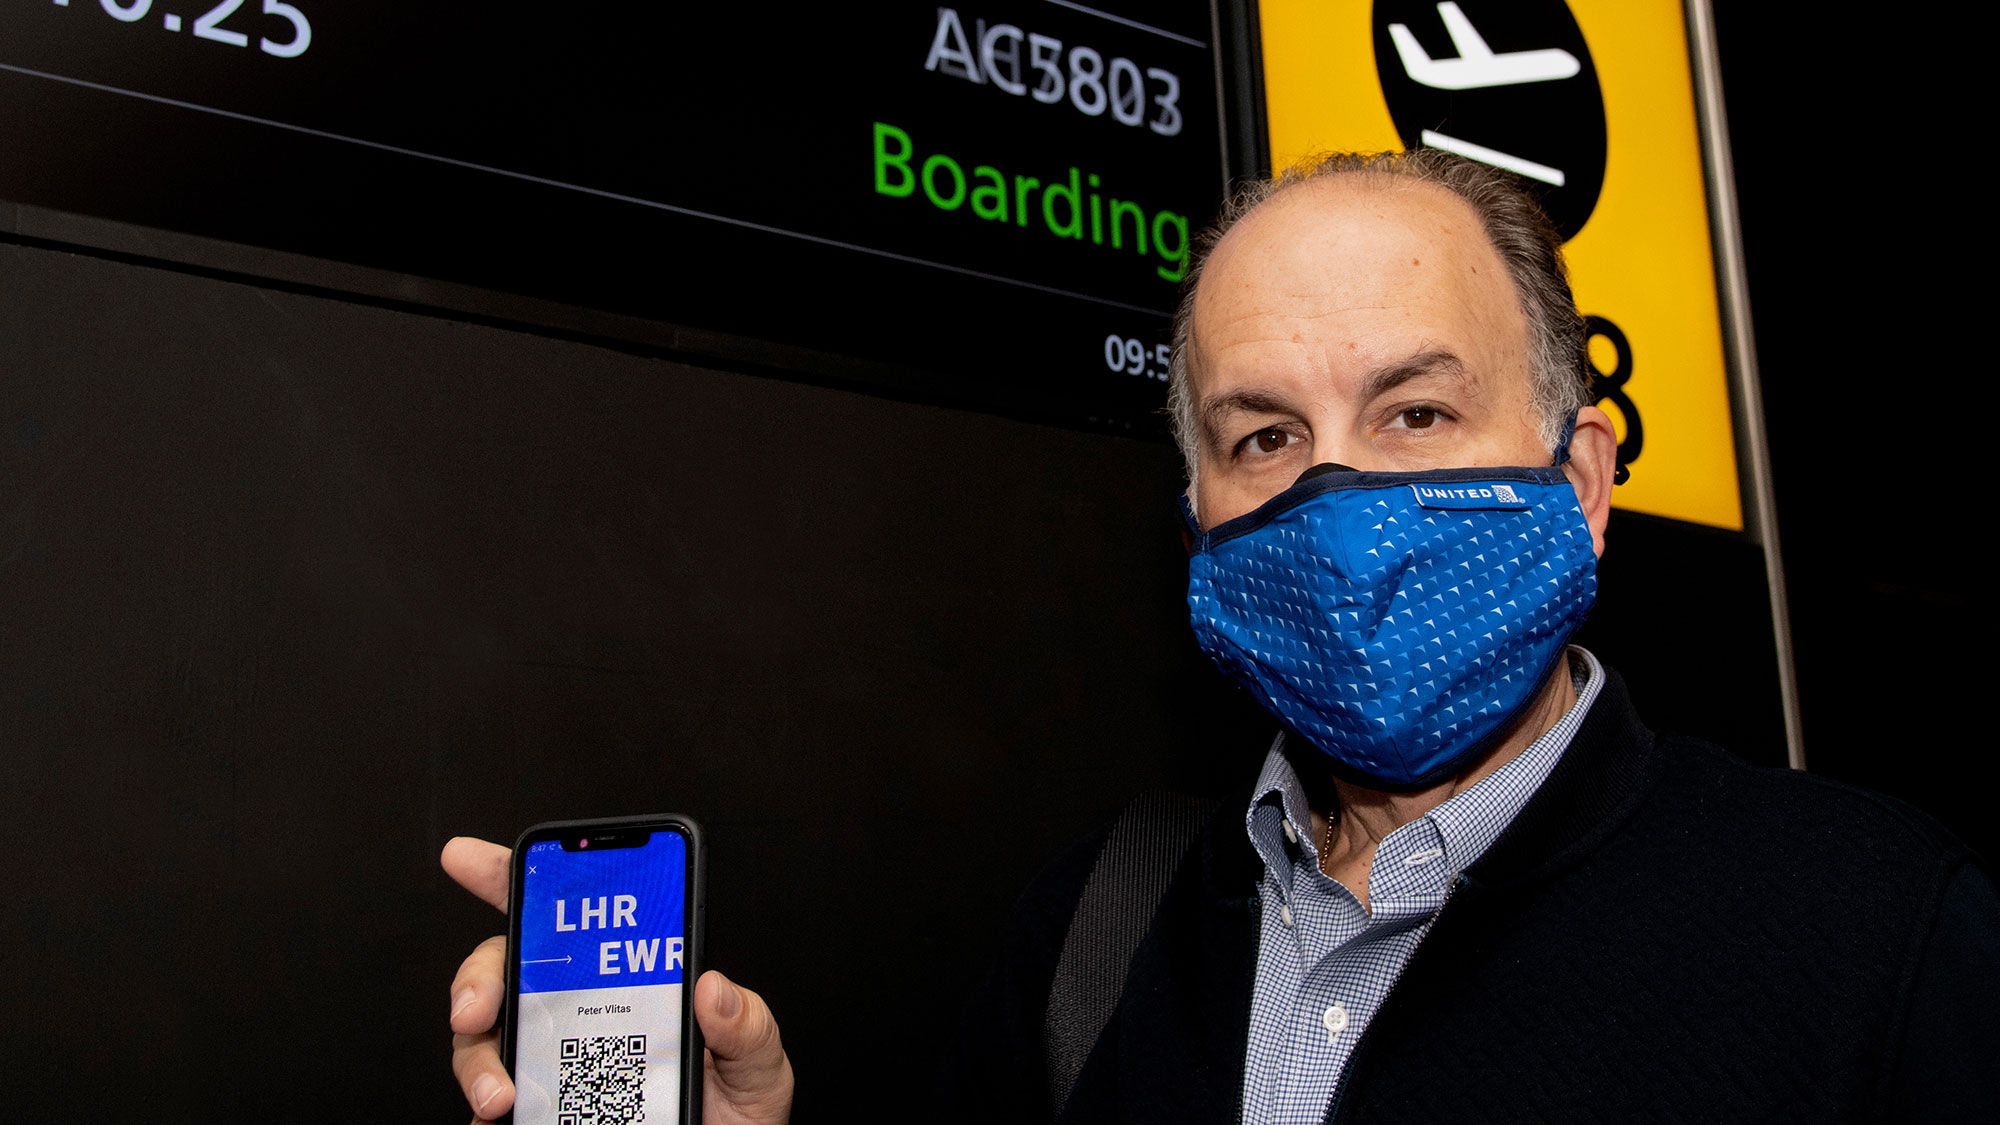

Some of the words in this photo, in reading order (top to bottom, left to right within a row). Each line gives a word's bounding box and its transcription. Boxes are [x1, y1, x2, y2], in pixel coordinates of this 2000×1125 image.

[873, 121, 1189, 282] Boarding
[1104, 334, 1172, 381] 09:5
[1420, 486, 1493, 499] UNITED
[556, 894, 638, 932] LHR
[599, 936, 684, 976] EWR
[577, 1006, 602, 1016] Peter
[604, 1004, 632, 1014] Vlitas
